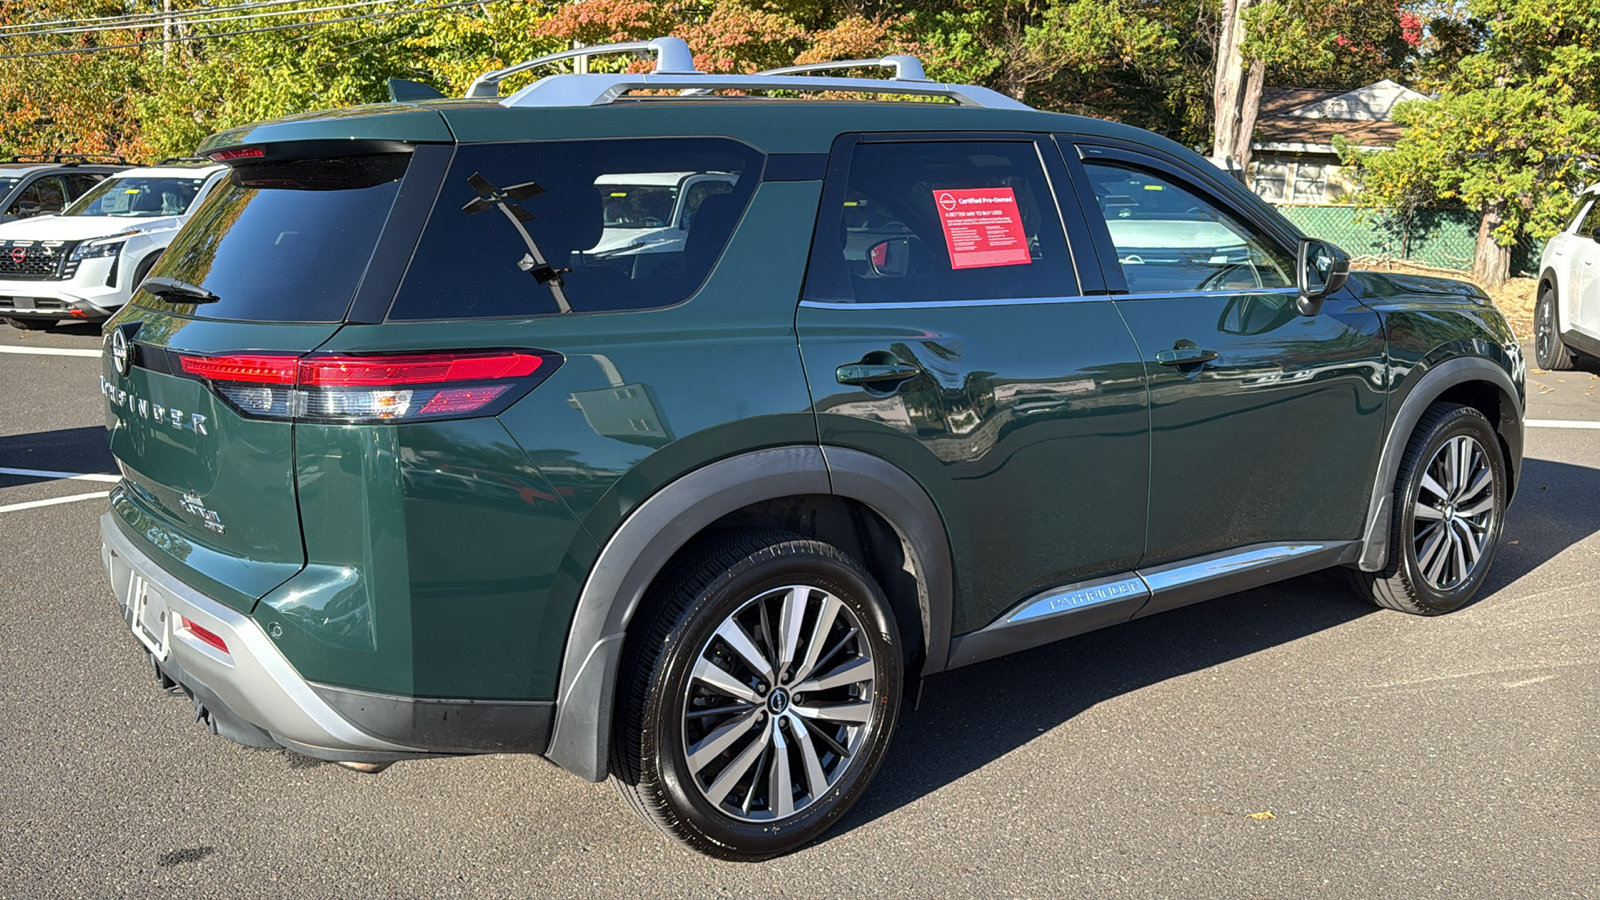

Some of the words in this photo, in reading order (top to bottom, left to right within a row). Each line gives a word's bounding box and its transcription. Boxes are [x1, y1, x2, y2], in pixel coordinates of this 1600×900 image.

[958, 197, 982, 205] Certified
[982, 196, 1013, 204] Pre-Owned
[100, 373, 208, 436] THFINDER
[1048, 581, 1140, 610] PATHFINDER
